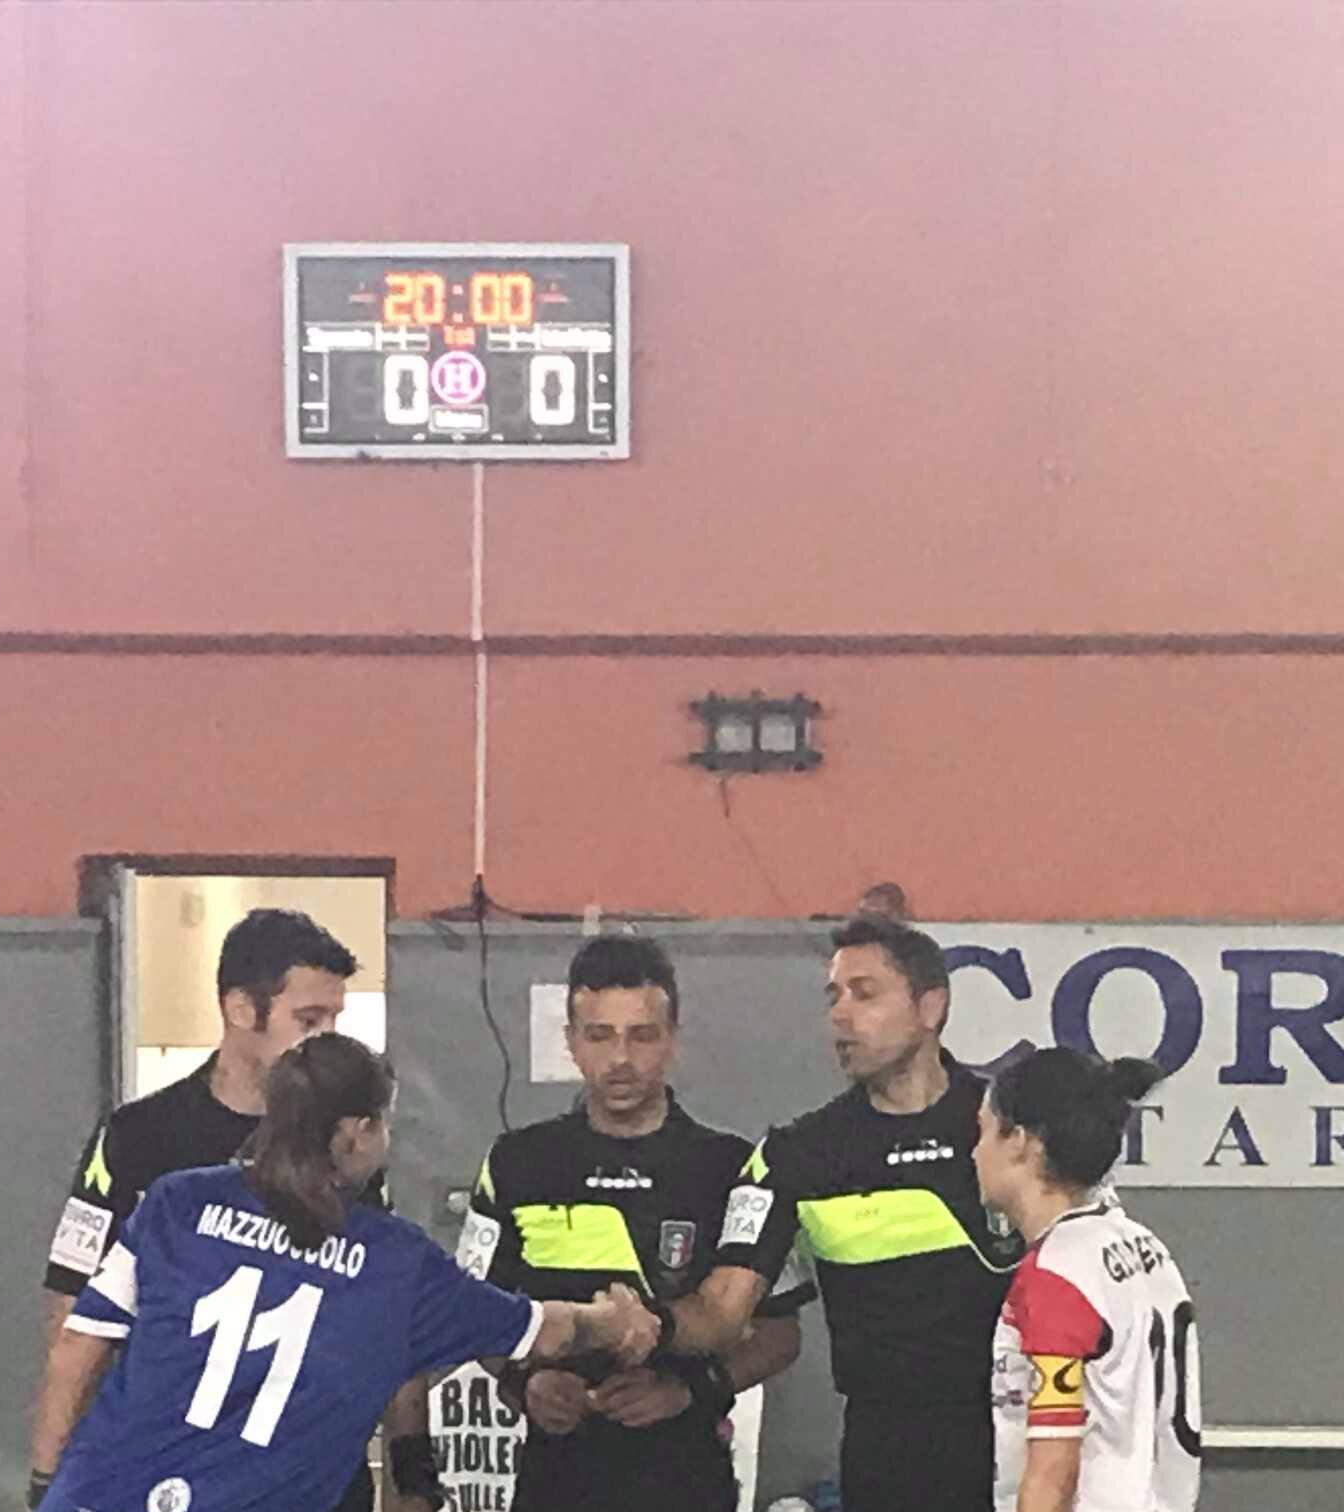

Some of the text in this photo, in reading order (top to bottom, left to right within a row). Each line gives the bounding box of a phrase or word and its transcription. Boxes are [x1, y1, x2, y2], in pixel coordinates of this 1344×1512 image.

[384, 271, 533, 325] 20:00
[384, 355, 429, 425] 0
[530, 355, 575, 425] 0
[185, 1265, 323, 1447] 11
